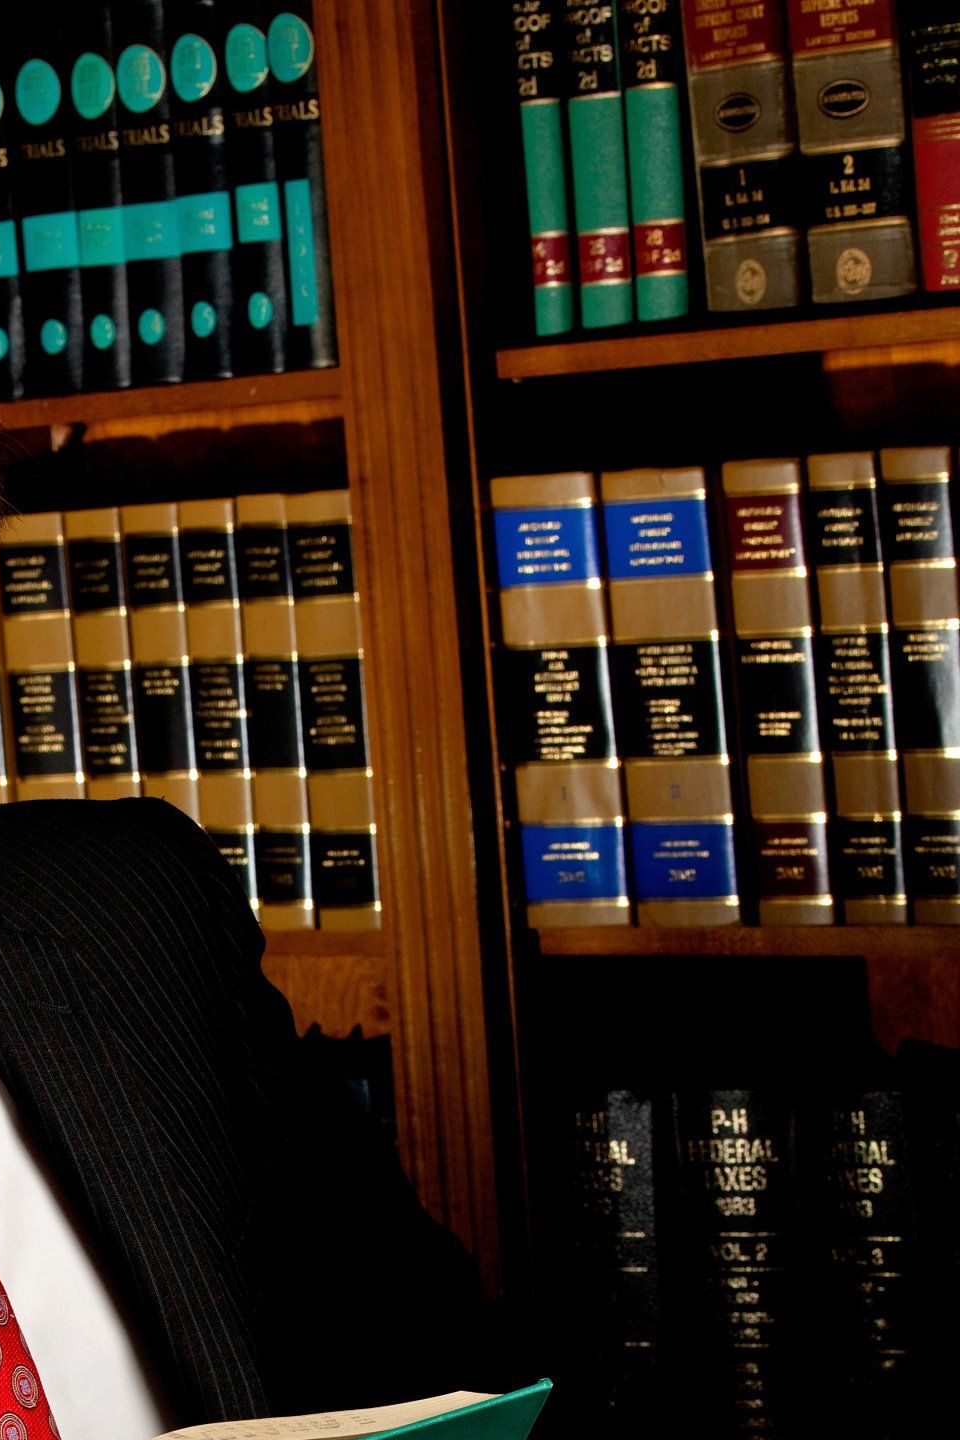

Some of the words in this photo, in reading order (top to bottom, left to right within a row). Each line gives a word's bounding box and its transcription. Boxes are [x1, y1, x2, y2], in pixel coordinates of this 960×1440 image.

[633, 16, 653, 34] of
[819, 9, 860, 28] REPORTS
[575, 27, 593, 45] of
[518, 50, 554, 70] CTS
[635, 58, 658, 80] 2d
[516, 74, 538, 97] 2d
[577, 69, 599, 91] 2d
[842, 153, 856, 176] 2
[710, 1107, 749, 1135] P-H
[754, 1241, 769, 1262] 2
